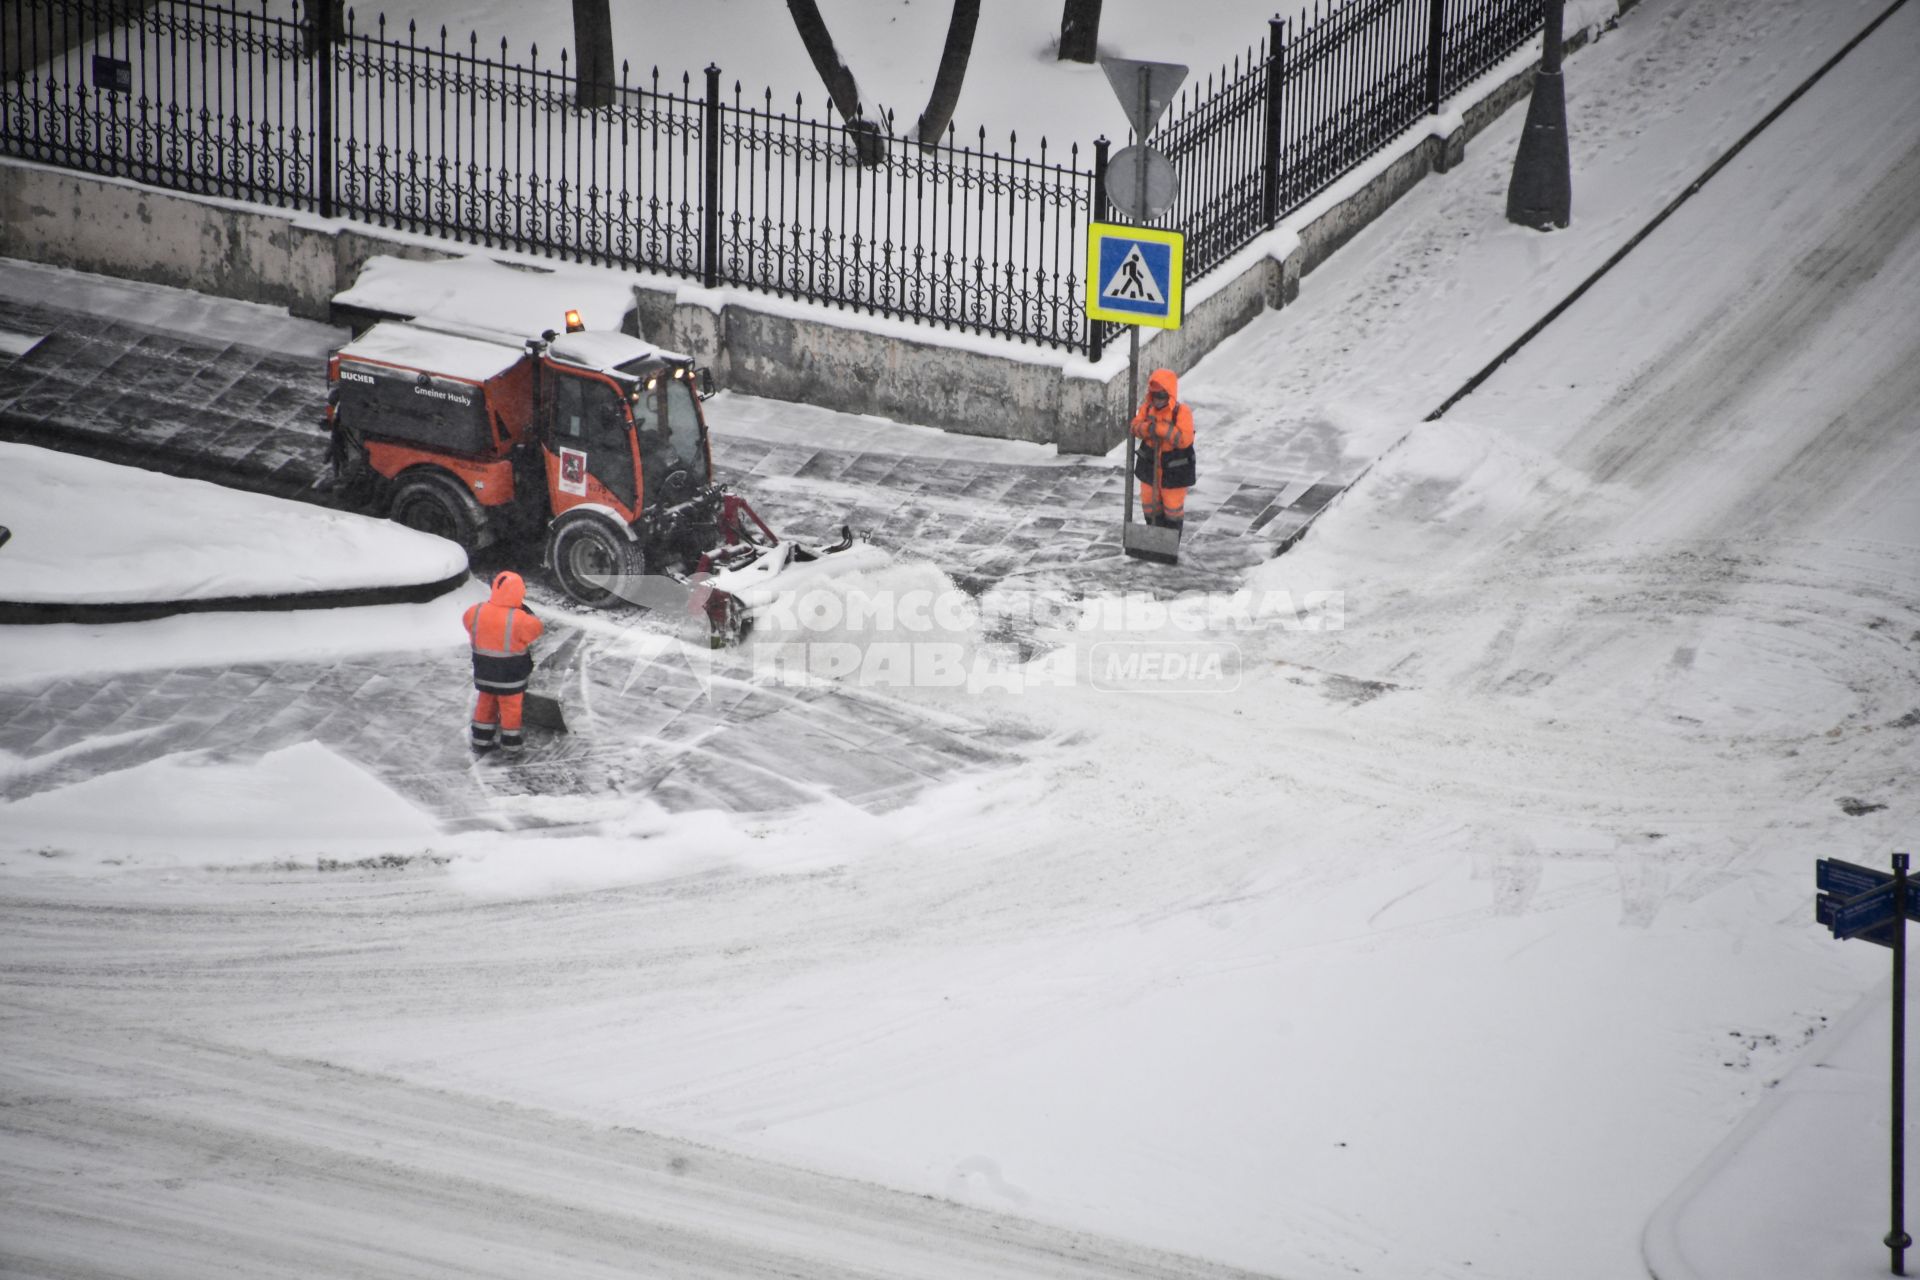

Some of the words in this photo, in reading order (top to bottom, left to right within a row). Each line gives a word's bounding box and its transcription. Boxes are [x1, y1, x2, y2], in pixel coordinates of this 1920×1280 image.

[340, 371, 375, 385] BUCHER
[414, 386, 446, 400] Gmeiner
[447, 392, 471, 406] Husky
